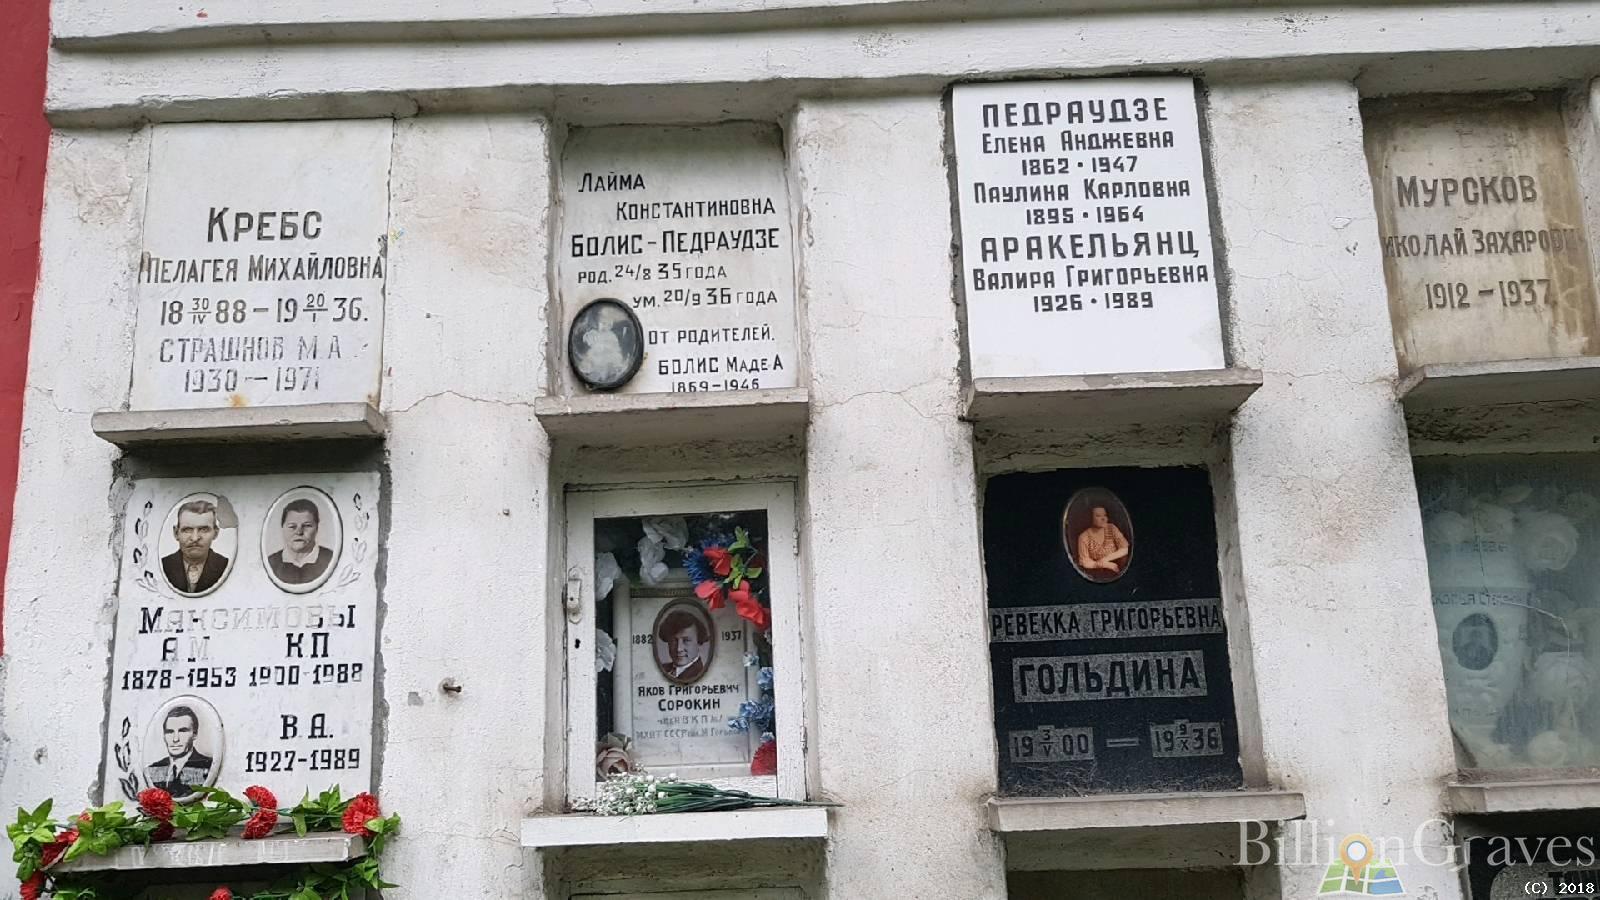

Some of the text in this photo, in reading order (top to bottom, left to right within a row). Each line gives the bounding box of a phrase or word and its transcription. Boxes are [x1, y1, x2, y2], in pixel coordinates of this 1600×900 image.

[982, 98, 1168, 128] ПЕДРАУДЗЕ
[982, 130, 1174, 154] ЕЛЕНА АНДЖЕВНА
[1022, 158, 1070, 176] 1862
[1092, 155, 1138, 173] 1947
[578, 171, 646, 193] ЛАЙМА
[974, 178, 1191, 203] ПАУЛИНА КАРЛОВНА
[1396, 175, 1538, 208] МУРСКОВ
[616, 197, 776, 221] КОНСТАНТИНОВНА
[1026, 207, 1075, 225] 1895
[1097, 205, 1144, 223] 1964
[207, 207, 322, 243] КРЕБС
[980, 230, 1199, 263] АРАКЕЛЬЯНЦ
[1383, 227, 1468, 258] ИКОЛАЙ
[147, 252, 383, 284] ПЕЛАГЕЯ МИХАЙЛОВНА
[973, 264, 1209, 291] ВАЛИРА ГРИГОРЬЕВНА
[1034, 294, 1083, 312] 1926
[1105, 291, 1154, 309] 1989
[648, 323, 775, 345] ОТ РОДИТЕЛЕЙ.
[159, 336, 284, 363] СТРАШНОВ
[658, 357, 719, 375] БОЛИС
[992, 605, 1221, 636] РЕВЕККА ГРИГОРЬЕВНА
[1019, 657, 1200, 697] ГОЛЬДИНА
[638, 686, 665, 697] ЯКОВ
[658, 698, 721, 712] СОРОКИН
[245, 748, 360, 773] 1927-1989
